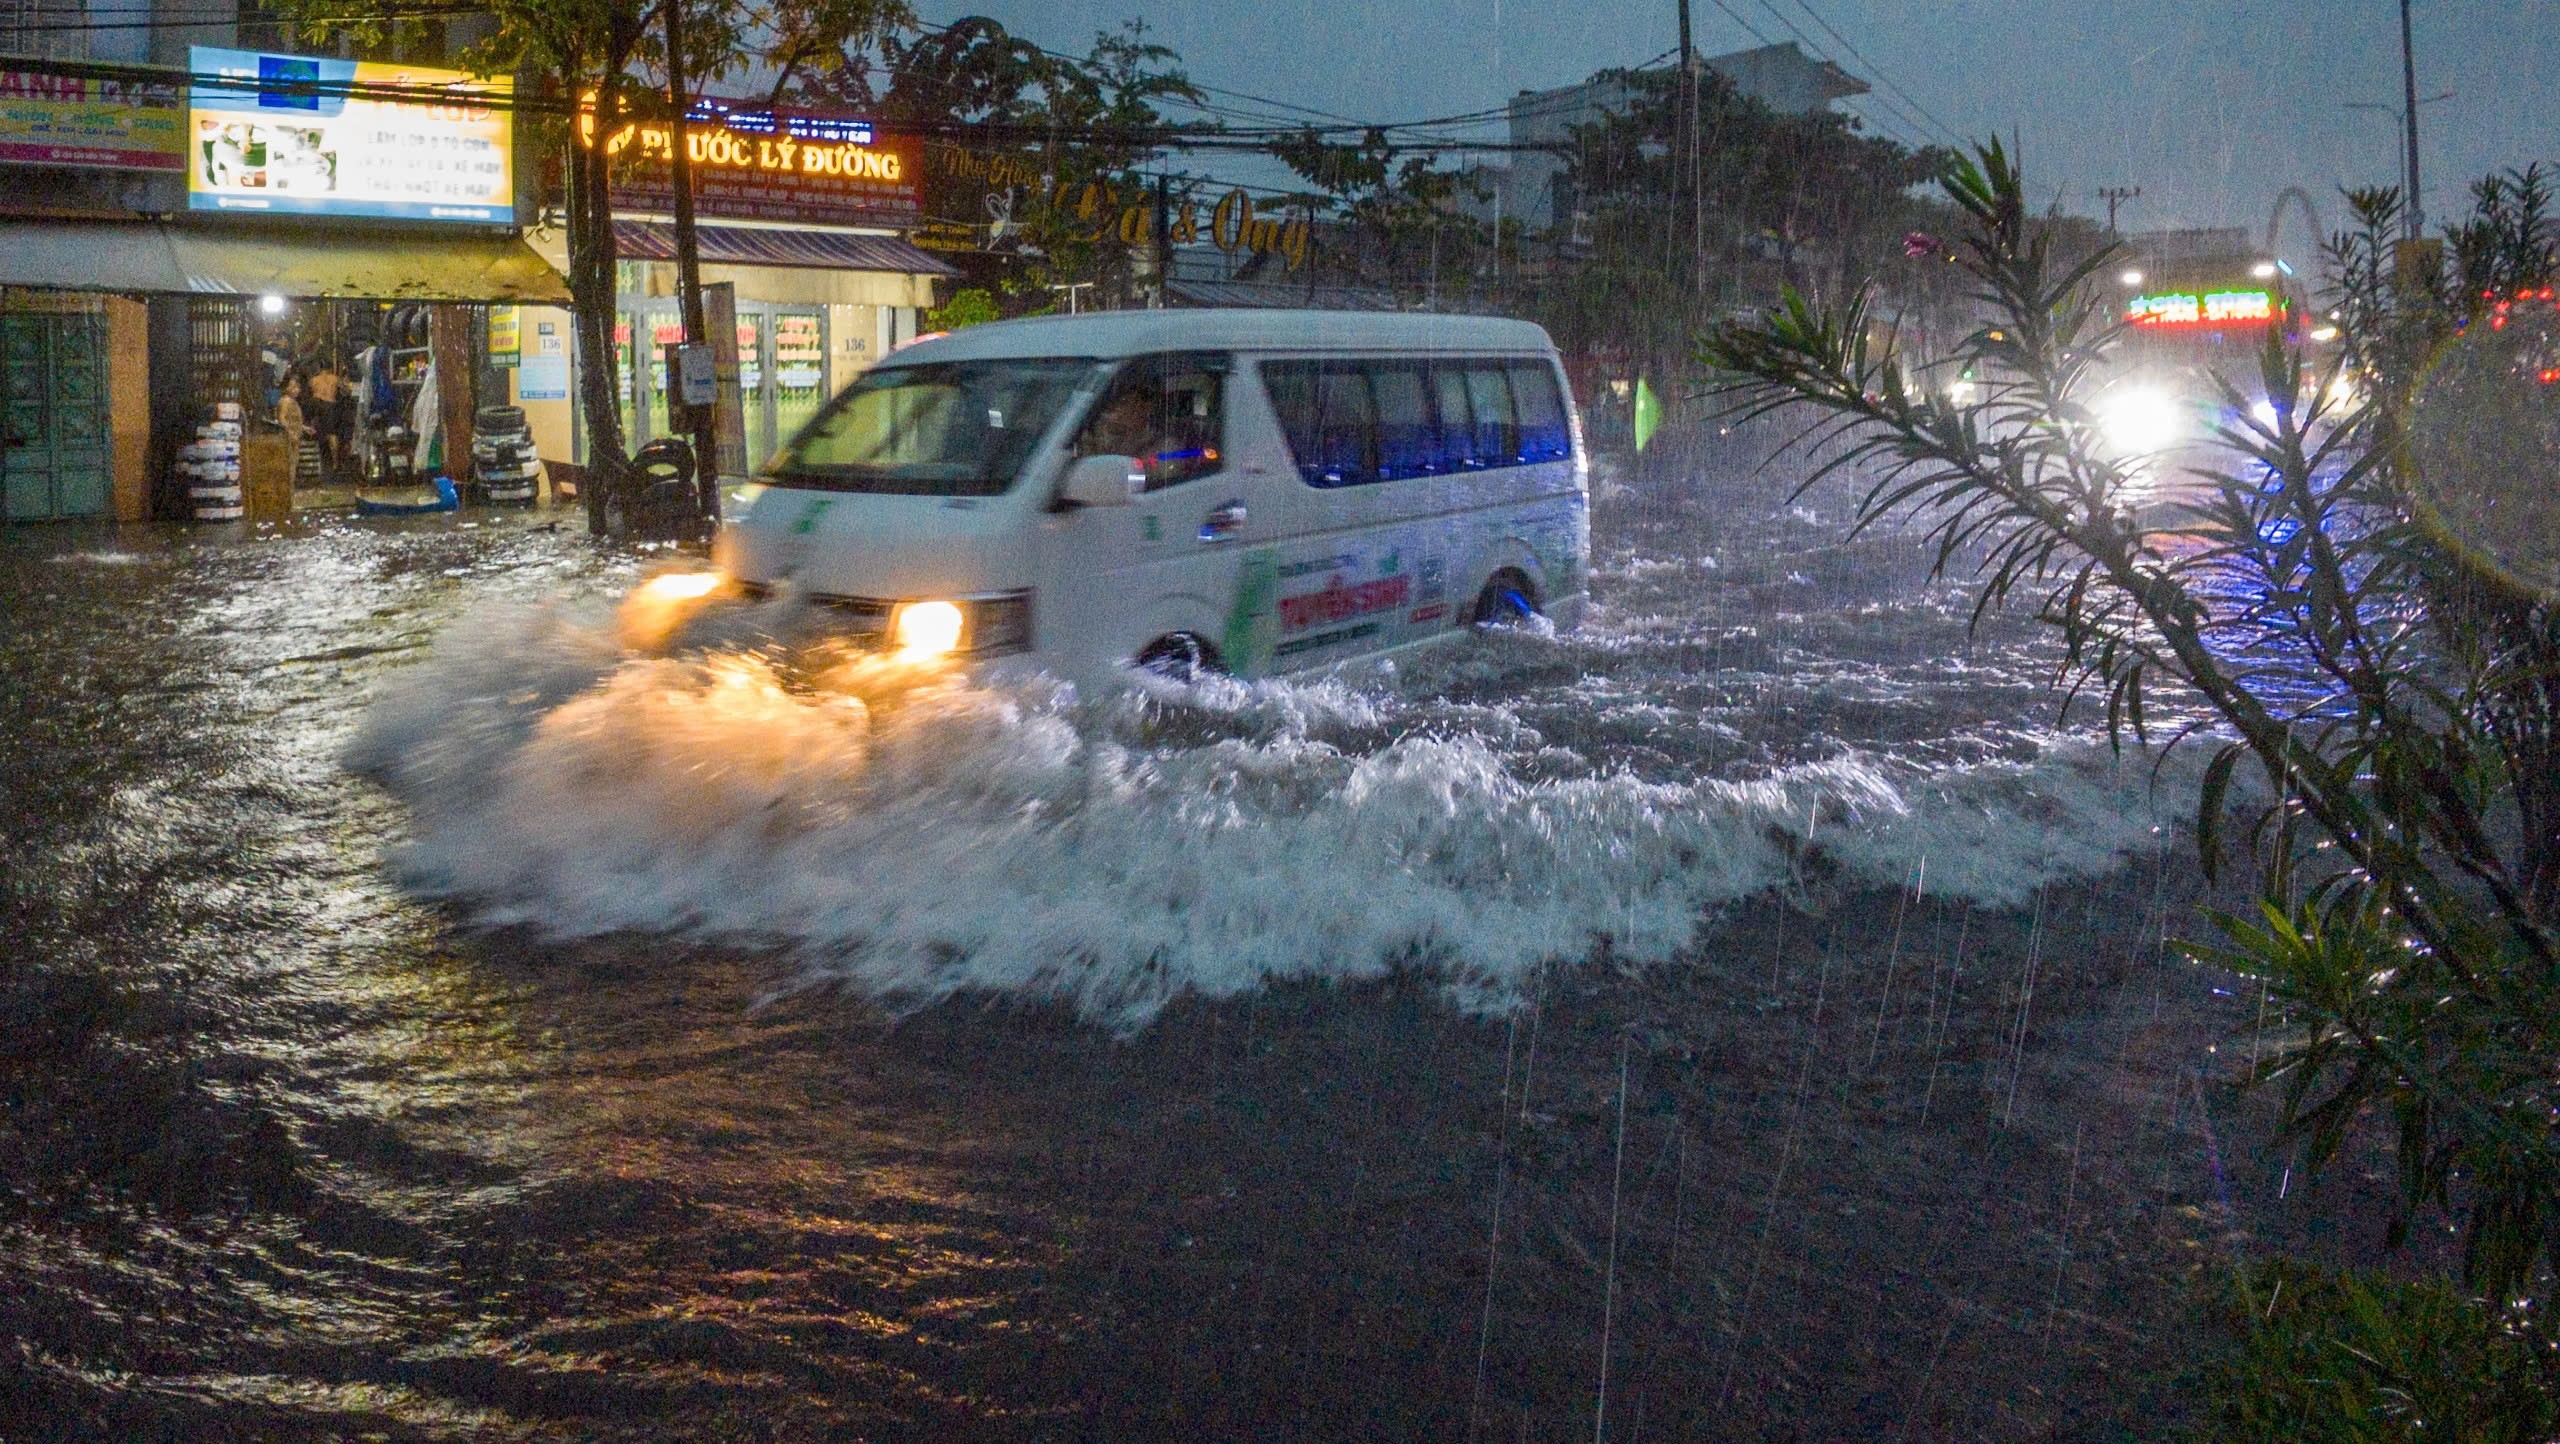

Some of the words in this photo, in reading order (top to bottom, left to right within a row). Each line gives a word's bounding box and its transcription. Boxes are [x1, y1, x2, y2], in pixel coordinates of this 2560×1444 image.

[759, 136, 797, 170] LÝ
[802, 143, 901, 180] ĐƯỜNG
[1171, 203, 1197, 243] &
[1213, 188, 1309, 271] Ong
[543, 338, 560, 350] 136
[845, 338, 866, 352] 136
